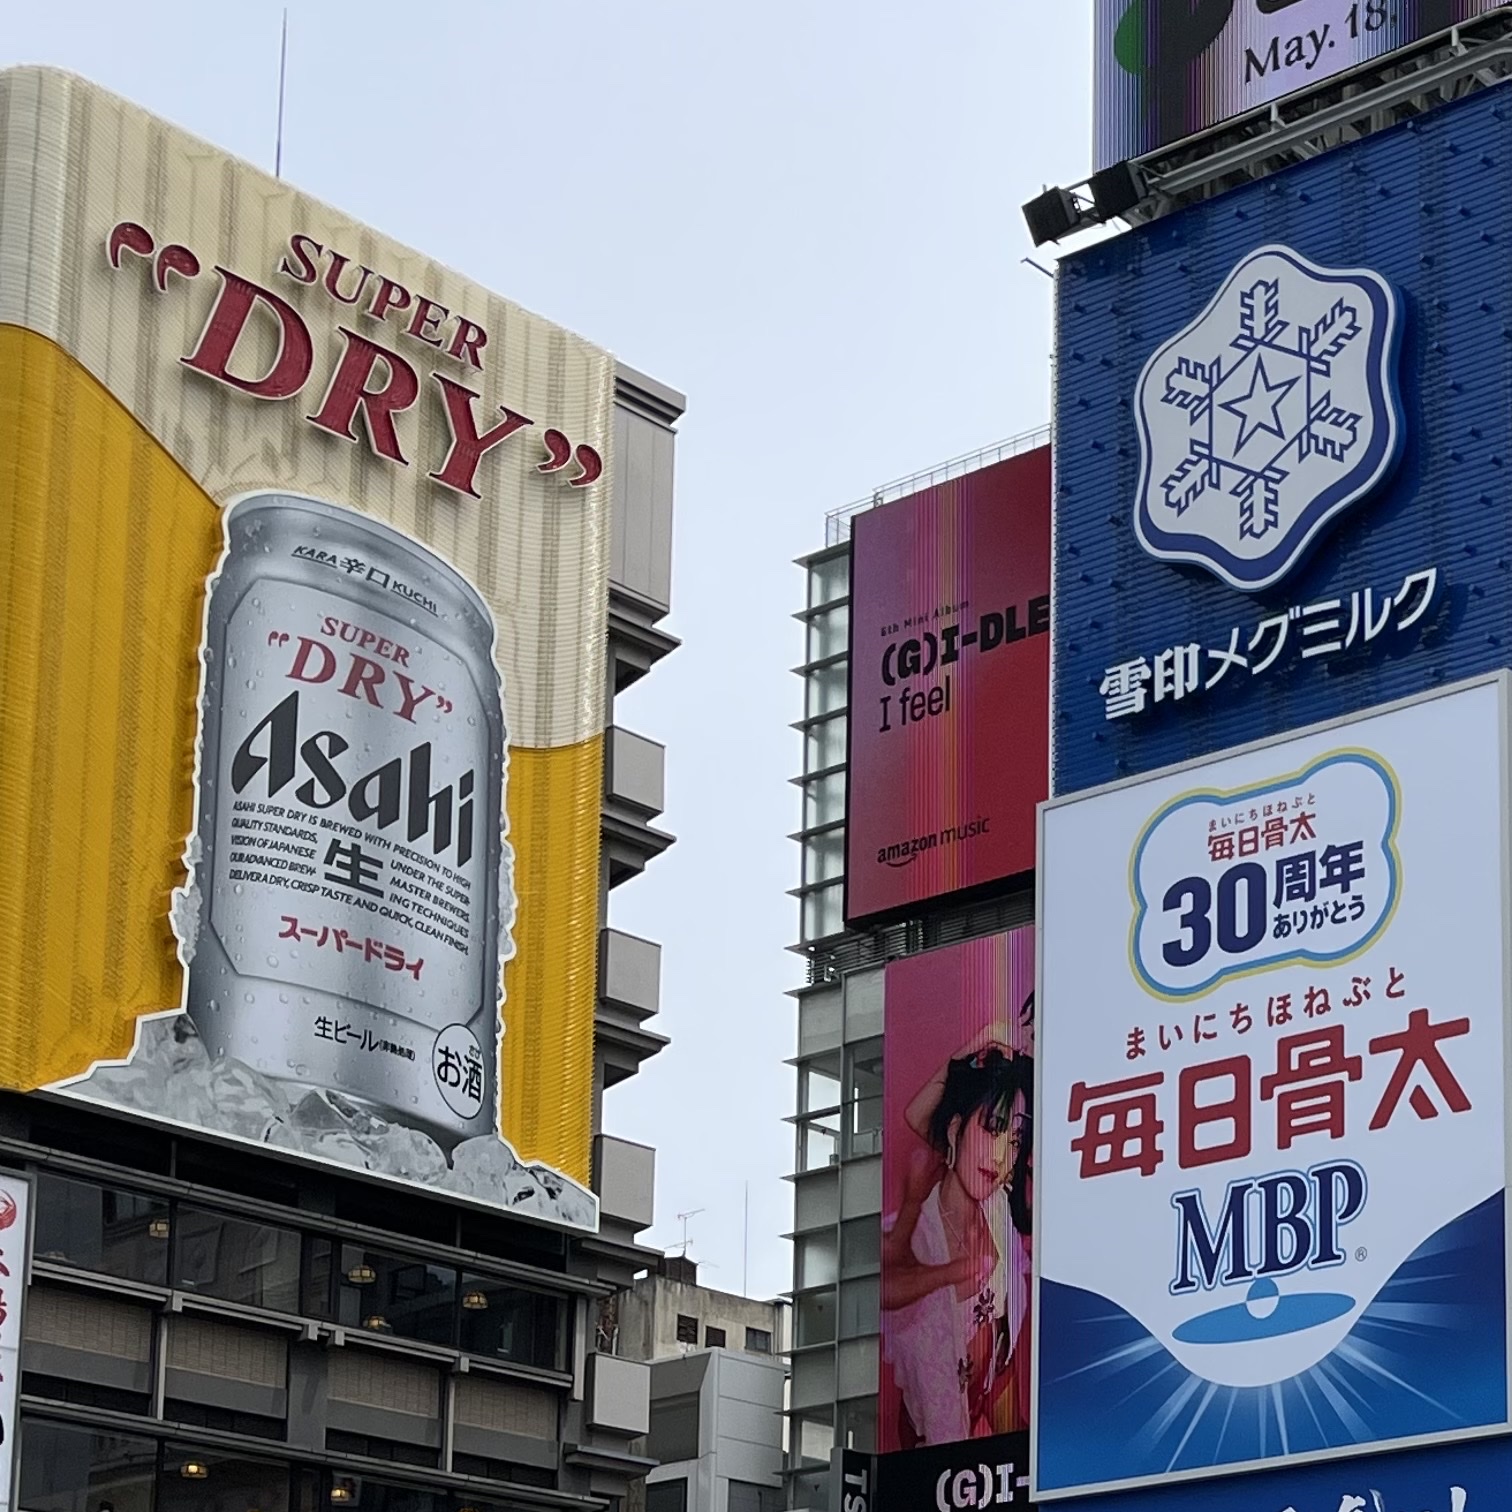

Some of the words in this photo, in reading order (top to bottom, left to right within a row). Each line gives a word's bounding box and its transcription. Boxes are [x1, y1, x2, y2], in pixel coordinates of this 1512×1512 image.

[1245, 24, 1335, 84] May.
[280, 233, 489, 371] SUPER
[339, 556, 390, 590] 辛口
[320, 616, 410, 669] SUPER
[881, 594, 1050, 687] (G)I-DLE
[1100, 567, 1440, 720] 雪印メグミルク
[879, 695, 892, 733] I
[899, 675, 951, 726] feel
[231, 690, 475, 868] Asahi
[233, 801, 255, 814] ASAHI
[257, 803, 286, 818] SUPER
[286, 808, 308, 823] DRY
[308, 813, 318, 826] IS
[320, 817, 363, 839] BREWED
[364, 829, 392, 850] WITH
[392, 842, 441, 873] PRECISION
[876, 833, 938, 864] amazon
[940, 815, 991, 846] music
[1207, 812, 1318, 863] 毎日骨太
[1208, 793, 1317, 833] まいにちほねぶと
[324, 838, 385, 900] 生
[390, 859, 426, 883] UNDER
[426, 873, 444, 892] THE
[390, 876, 431, 902] MASTER
[320, 886, 353, 906] TASTE
[353, 897, 378, 913] AND
[1272, 895, 1366, 940] ありがとう
[279, 915, 425, 981] スーパードライ
[1126, 967, 1406, 1060] まいにちほねぶと
[437, 1045, 484, 1104] お酒
[1067, 1008, 1472, 1179] 毎日骨太
[1171, 1160, 1367, 1294] MBP
